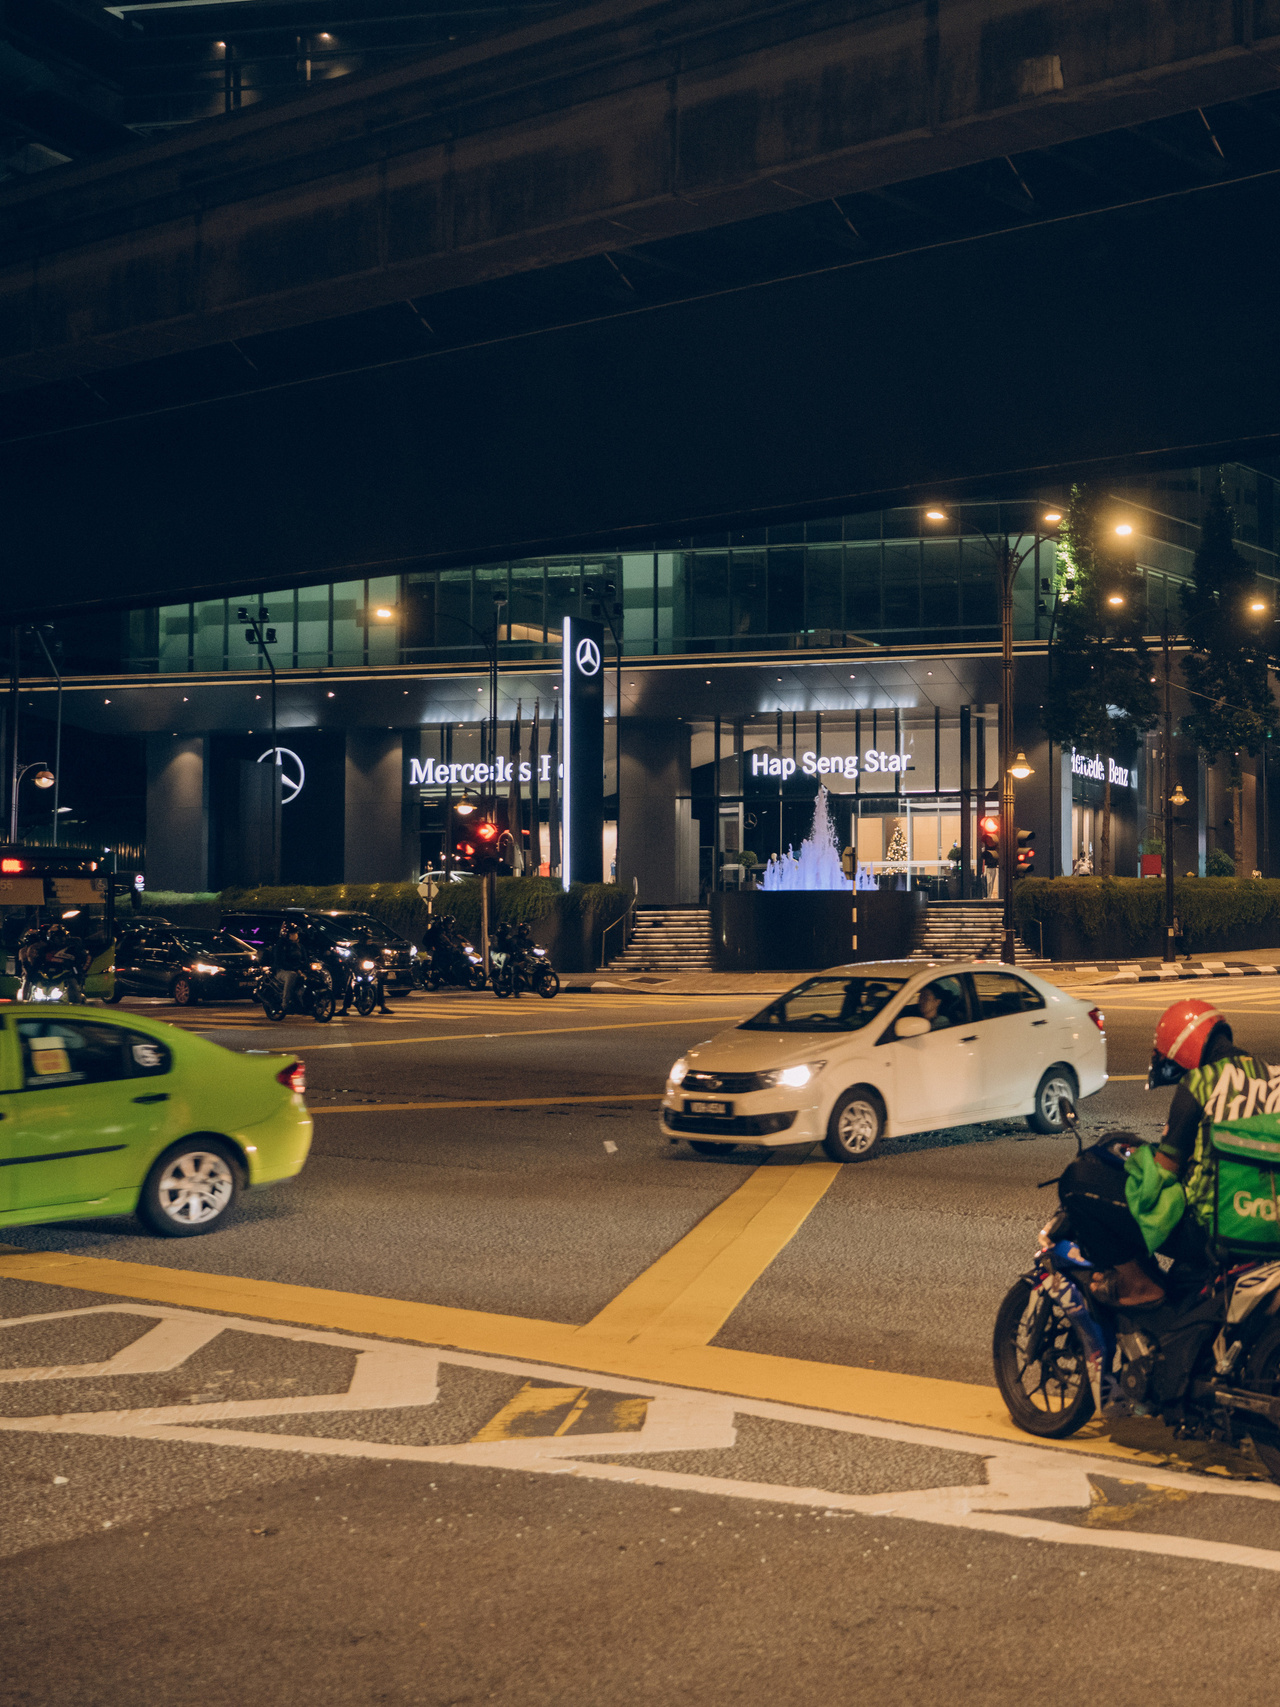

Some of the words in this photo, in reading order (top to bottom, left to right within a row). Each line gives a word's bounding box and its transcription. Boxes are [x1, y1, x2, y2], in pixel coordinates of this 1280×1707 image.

[752, 753, 796, 780] Hap
[802, 751, 858, 779] Seng
[864, 749, 911, 773] Star
